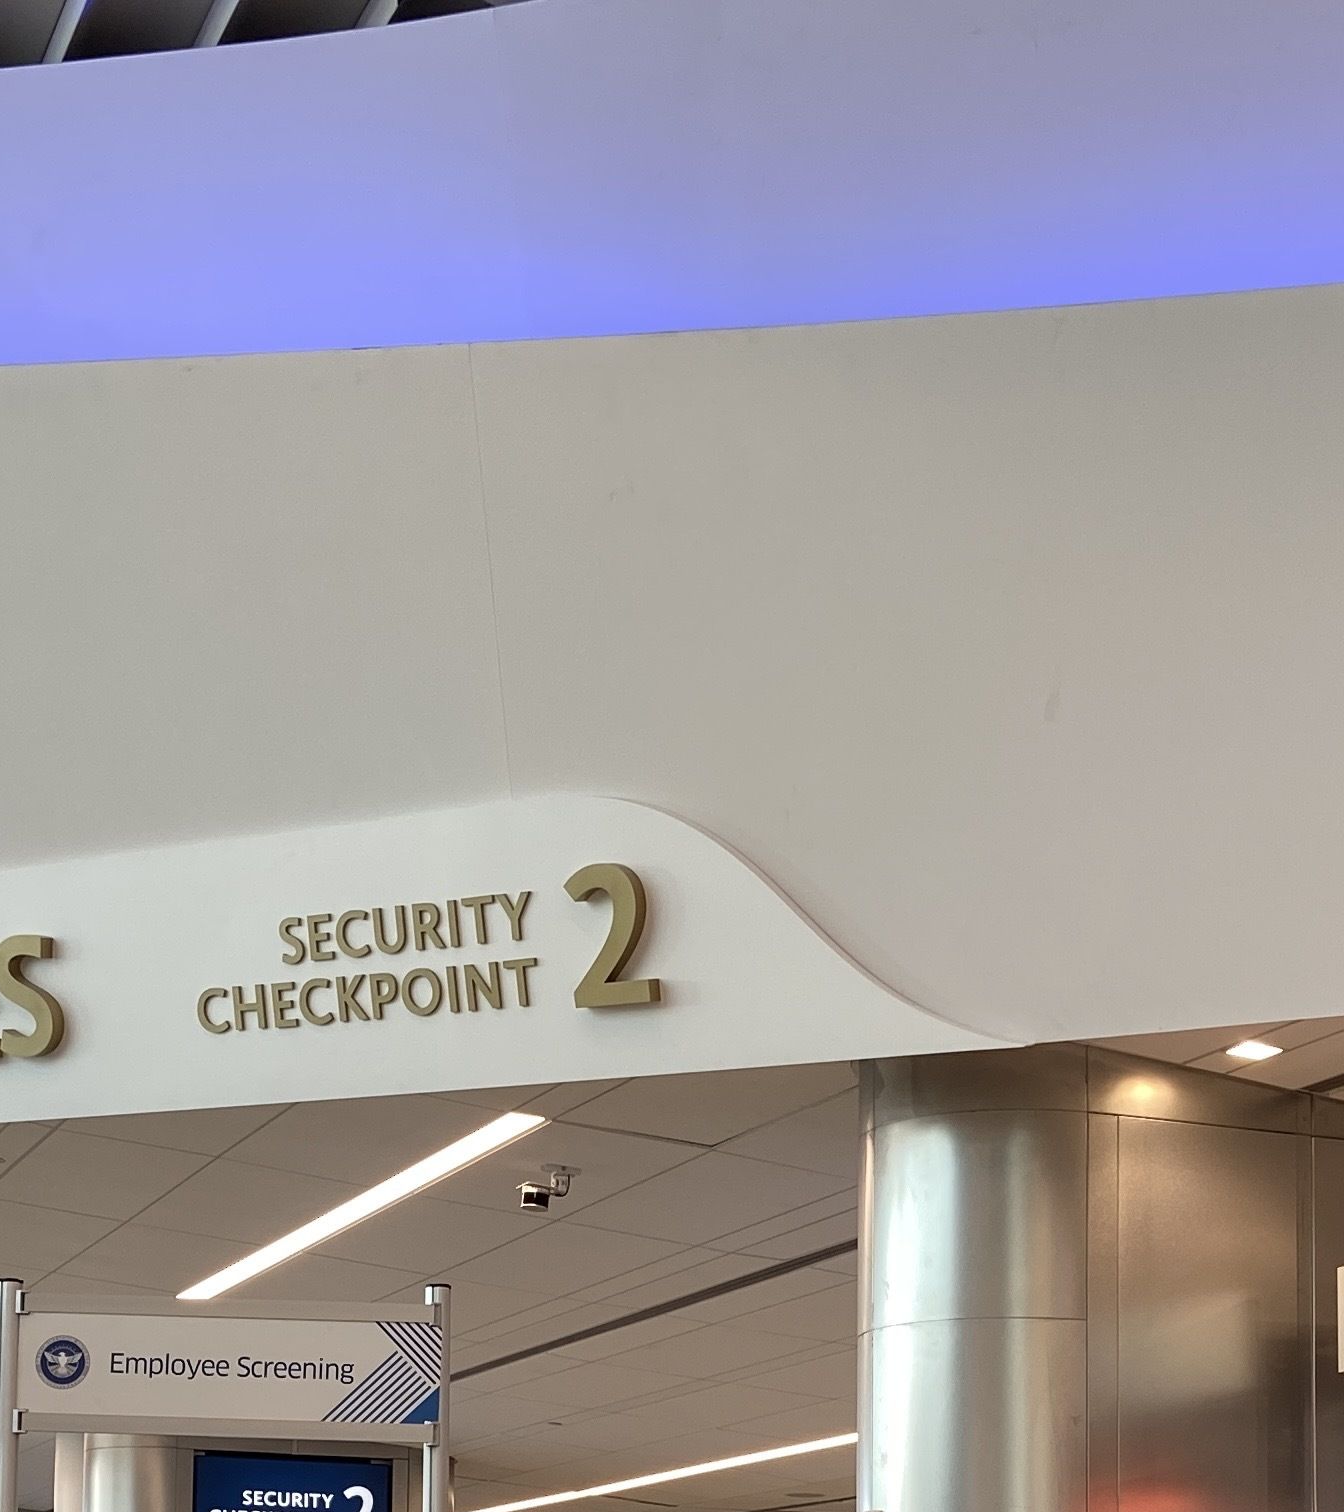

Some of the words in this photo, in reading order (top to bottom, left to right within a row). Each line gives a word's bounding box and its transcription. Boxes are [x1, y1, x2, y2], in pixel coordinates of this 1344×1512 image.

[196, 957, 538, 1034] CHECKPOINT
[562, 862, 661, 1009] 2
[277, 890, 532, 966] SECURITY
[109, 1351, 230, 1380] Employee
[236, 1355, 355, 1385] Screening
[242, 1489, 335, 1509] SECURITY
